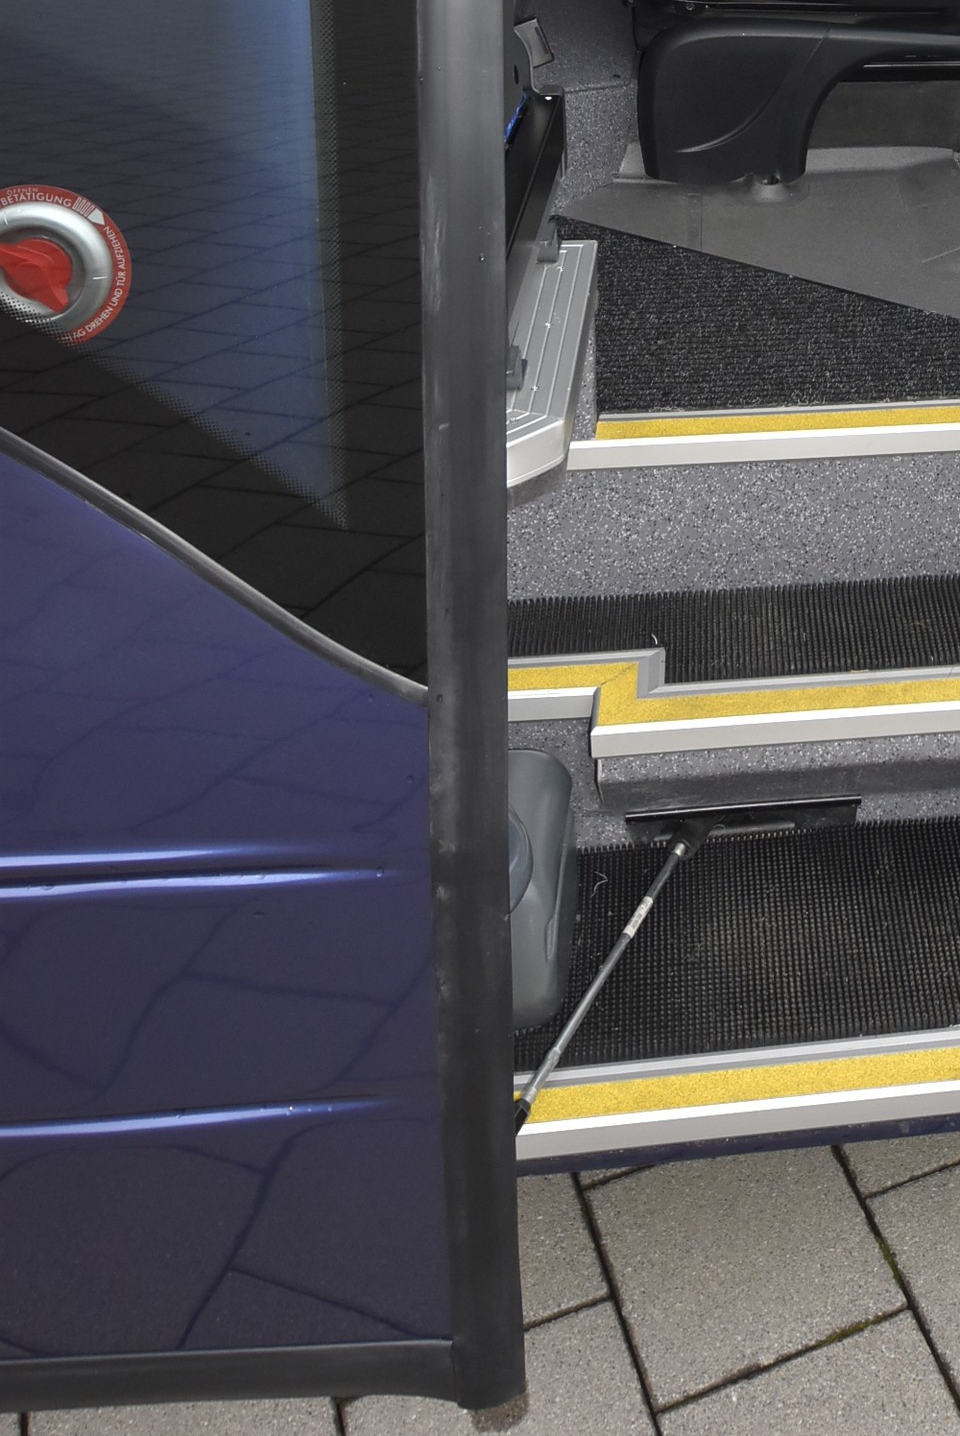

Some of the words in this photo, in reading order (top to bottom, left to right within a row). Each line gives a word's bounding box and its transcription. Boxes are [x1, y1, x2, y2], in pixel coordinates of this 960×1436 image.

[0, 192, 72, 207] BETÄTIGUNG
[103, 226, 127, 269] AUFZIEHEN
[110, 288, 123, 307] UND
[85, 306, 113, 332] DREHEN
